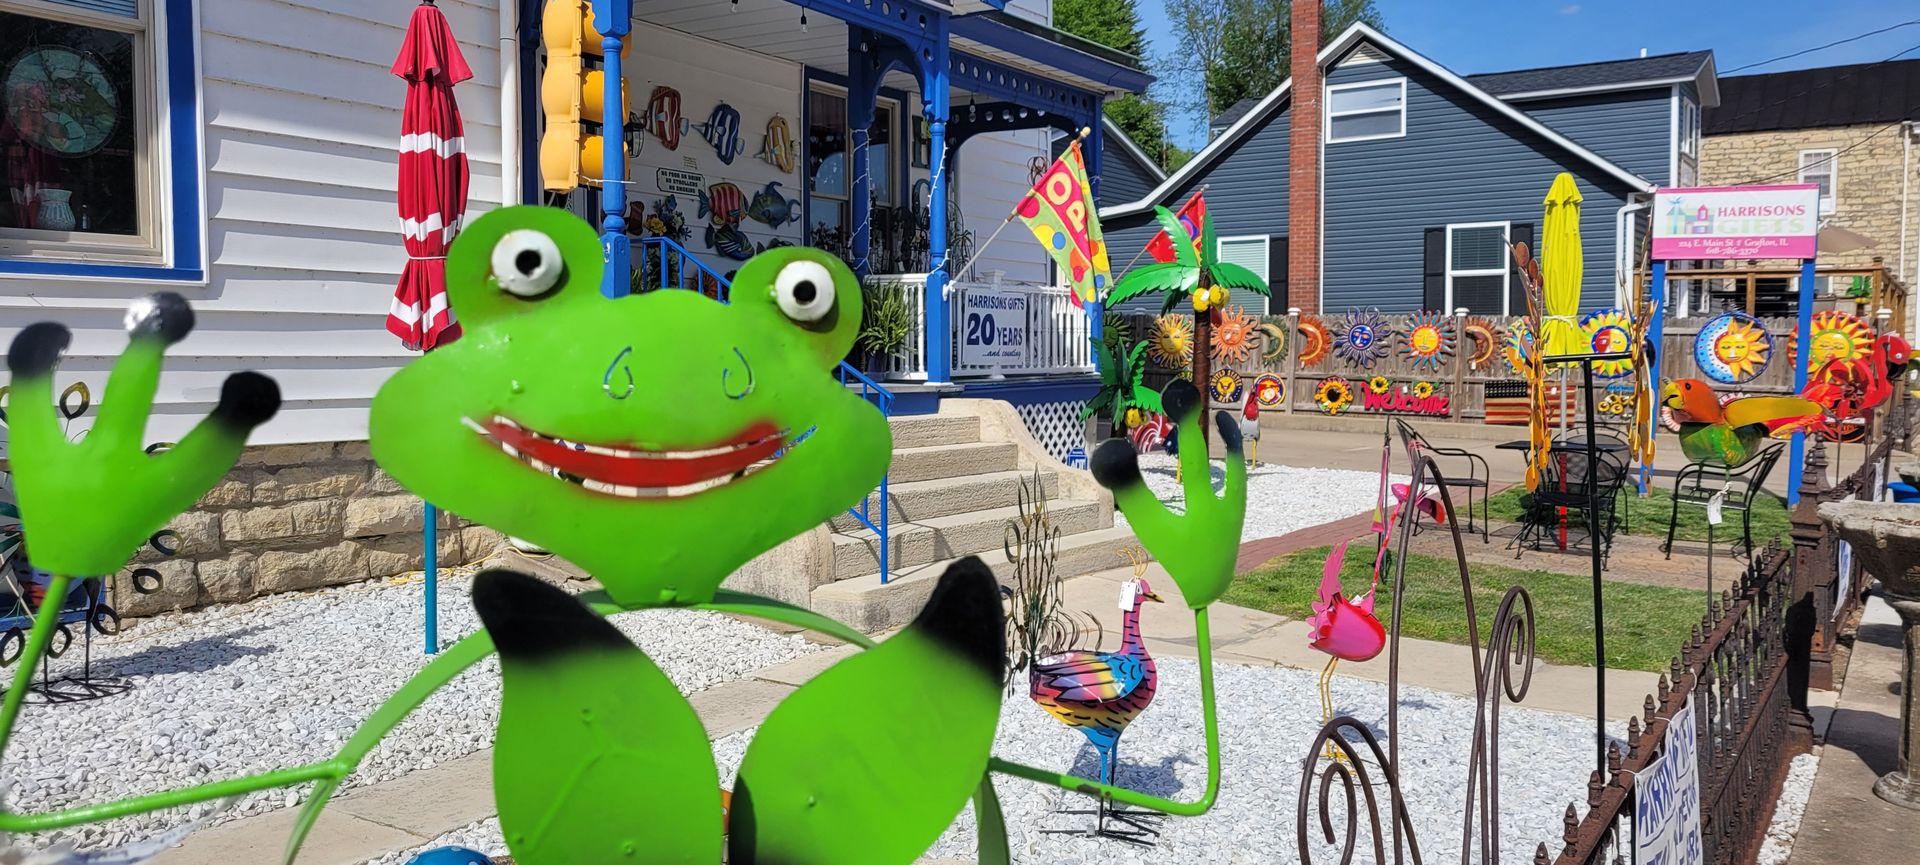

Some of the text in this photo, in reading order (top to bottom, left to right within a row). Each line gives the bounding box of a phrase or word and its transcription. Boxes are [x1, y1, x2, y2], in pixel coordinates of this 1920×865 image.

[1046, 172, 1088, 240] OP
[1718, 205, 1806, 217] HARRISONS
[1717, 218, 1805, 234] GIFTS
[1703, 238, 1724, 248] Main
[1779, 238, 1789, 247] IL
[968, 294, 1025, 311] HARRISONS GIFTS
[967, 313, 1023, 346] 20 YEARS
[1360, 381, 1450, 415] Welcome
